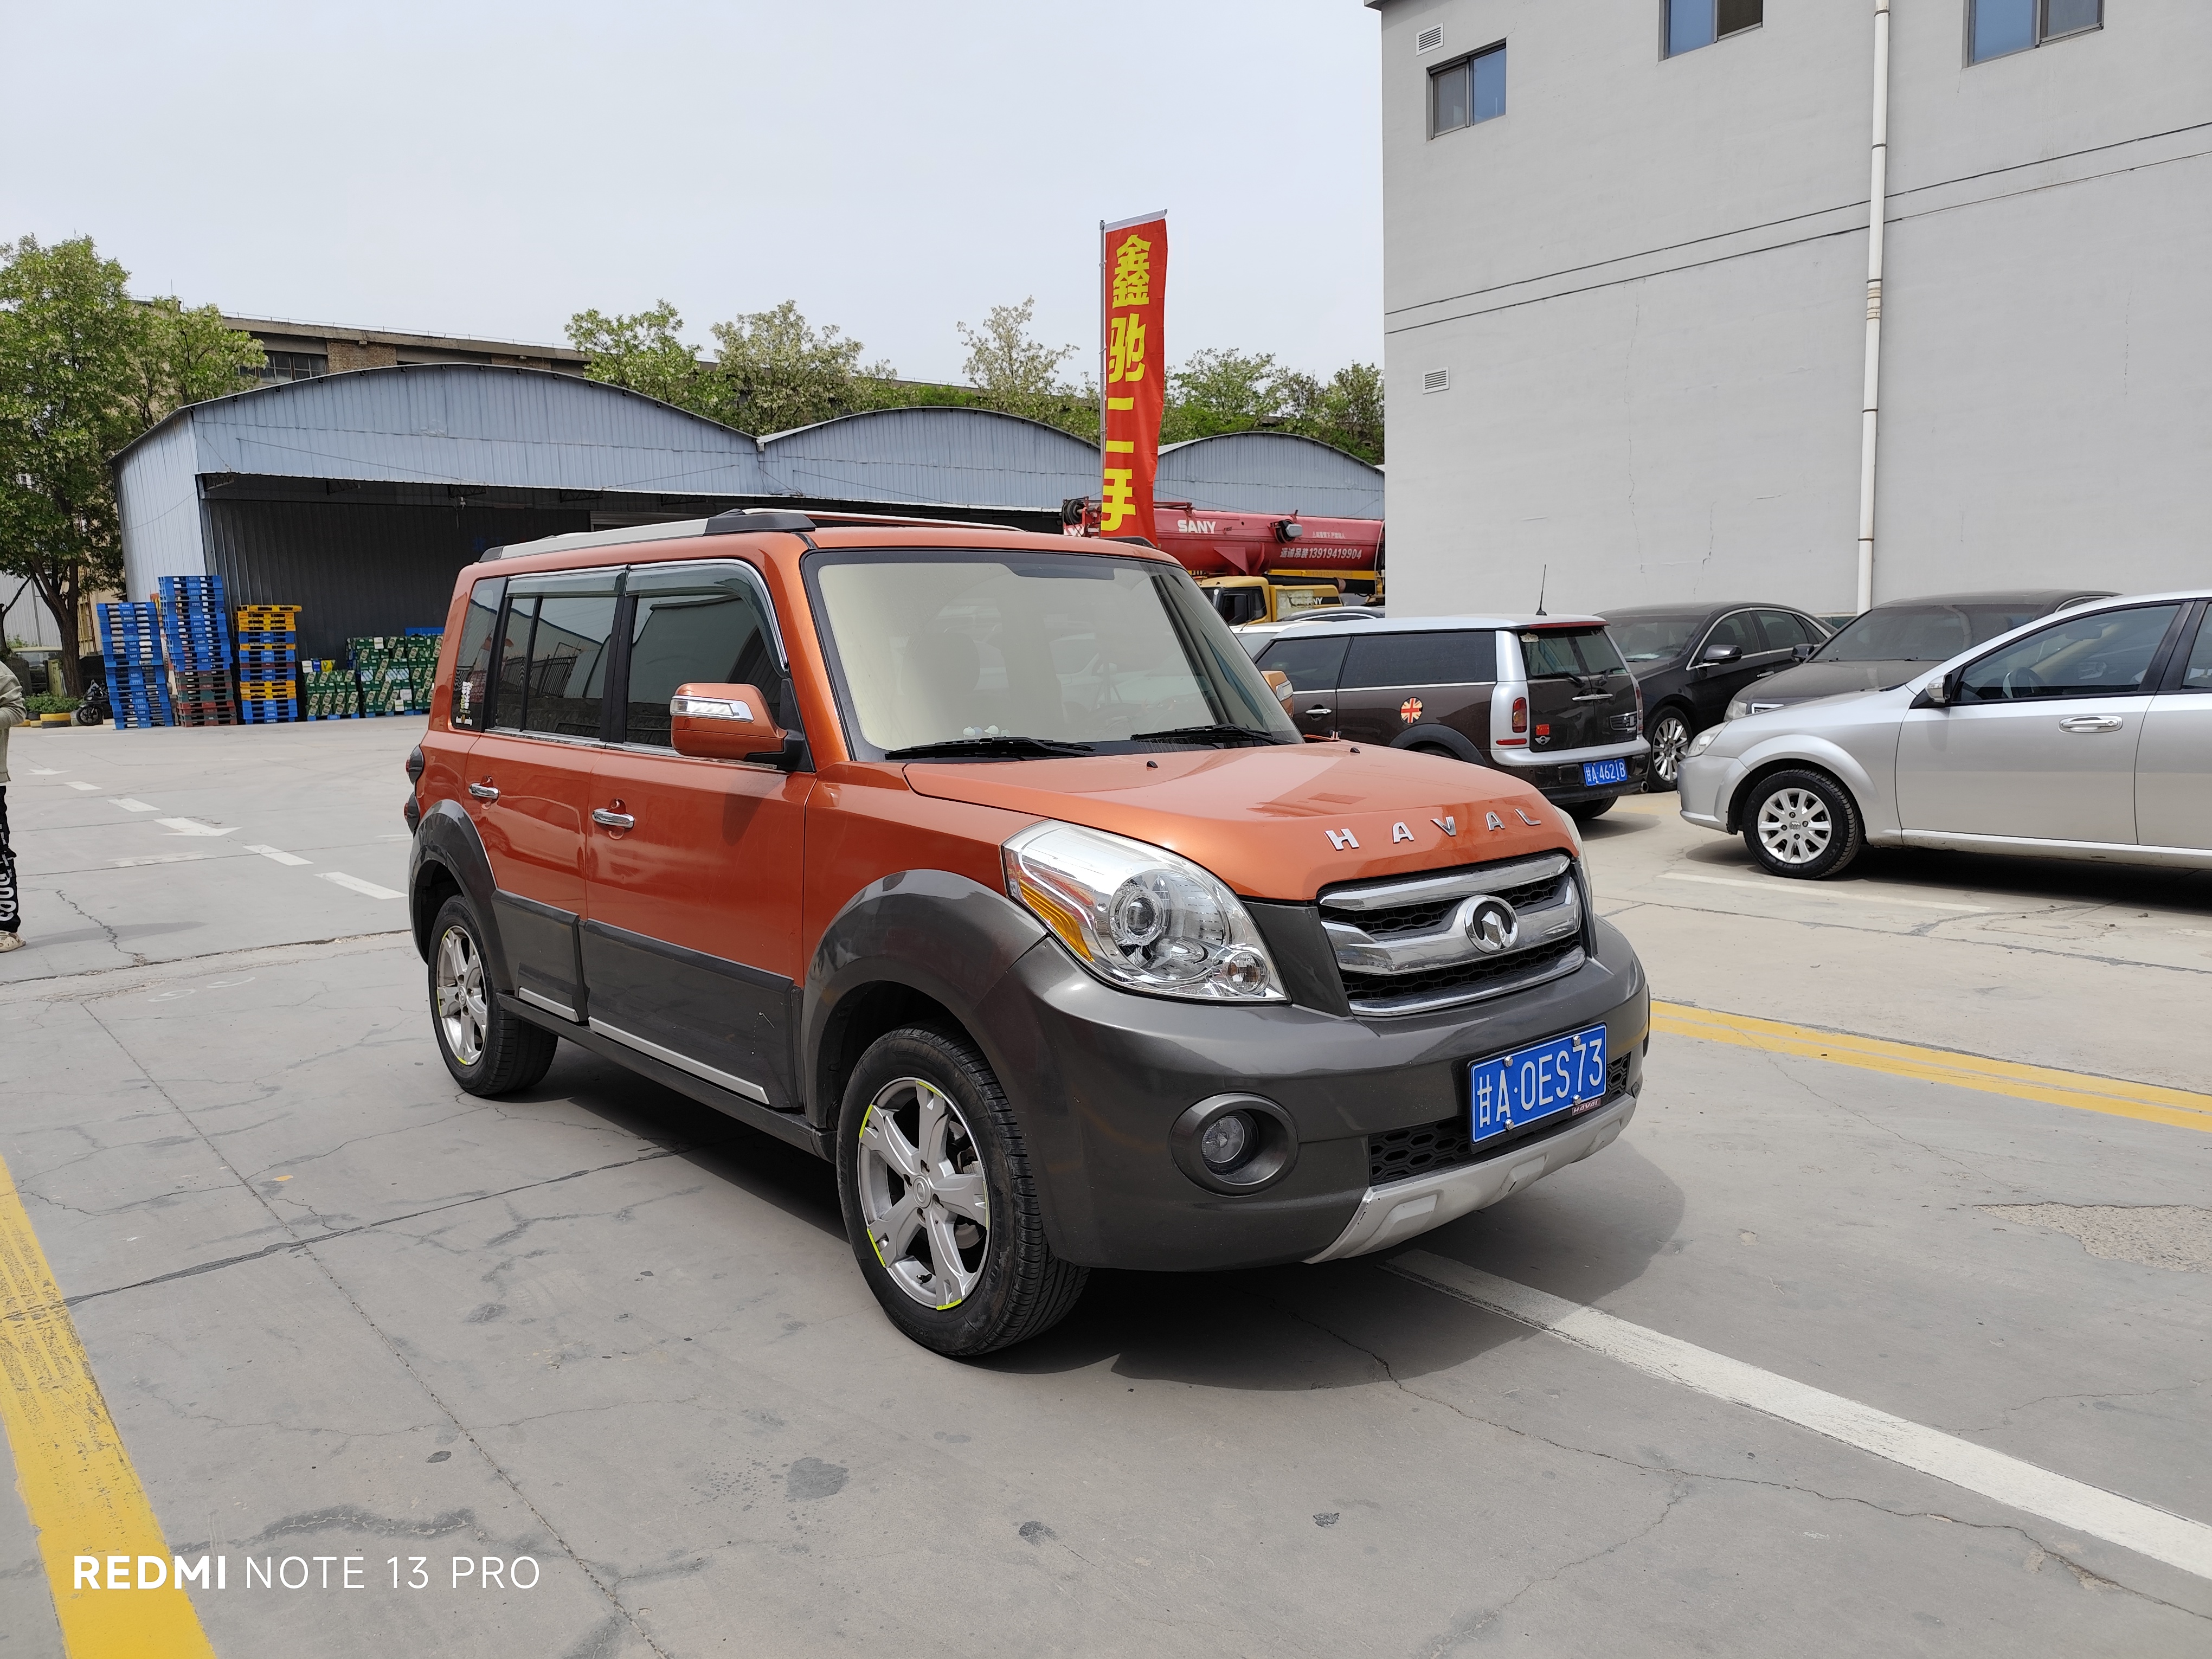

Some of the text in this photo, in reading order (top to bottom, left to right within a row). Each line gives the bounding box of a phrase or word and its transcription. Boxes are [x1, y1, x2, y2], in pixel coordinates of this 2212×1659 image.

[1101, 234, 1152, 531] 鑫驰二手
[1177, 519, 1216, 534] SANY
[1324, 808, 1541, 851] HAVAL
